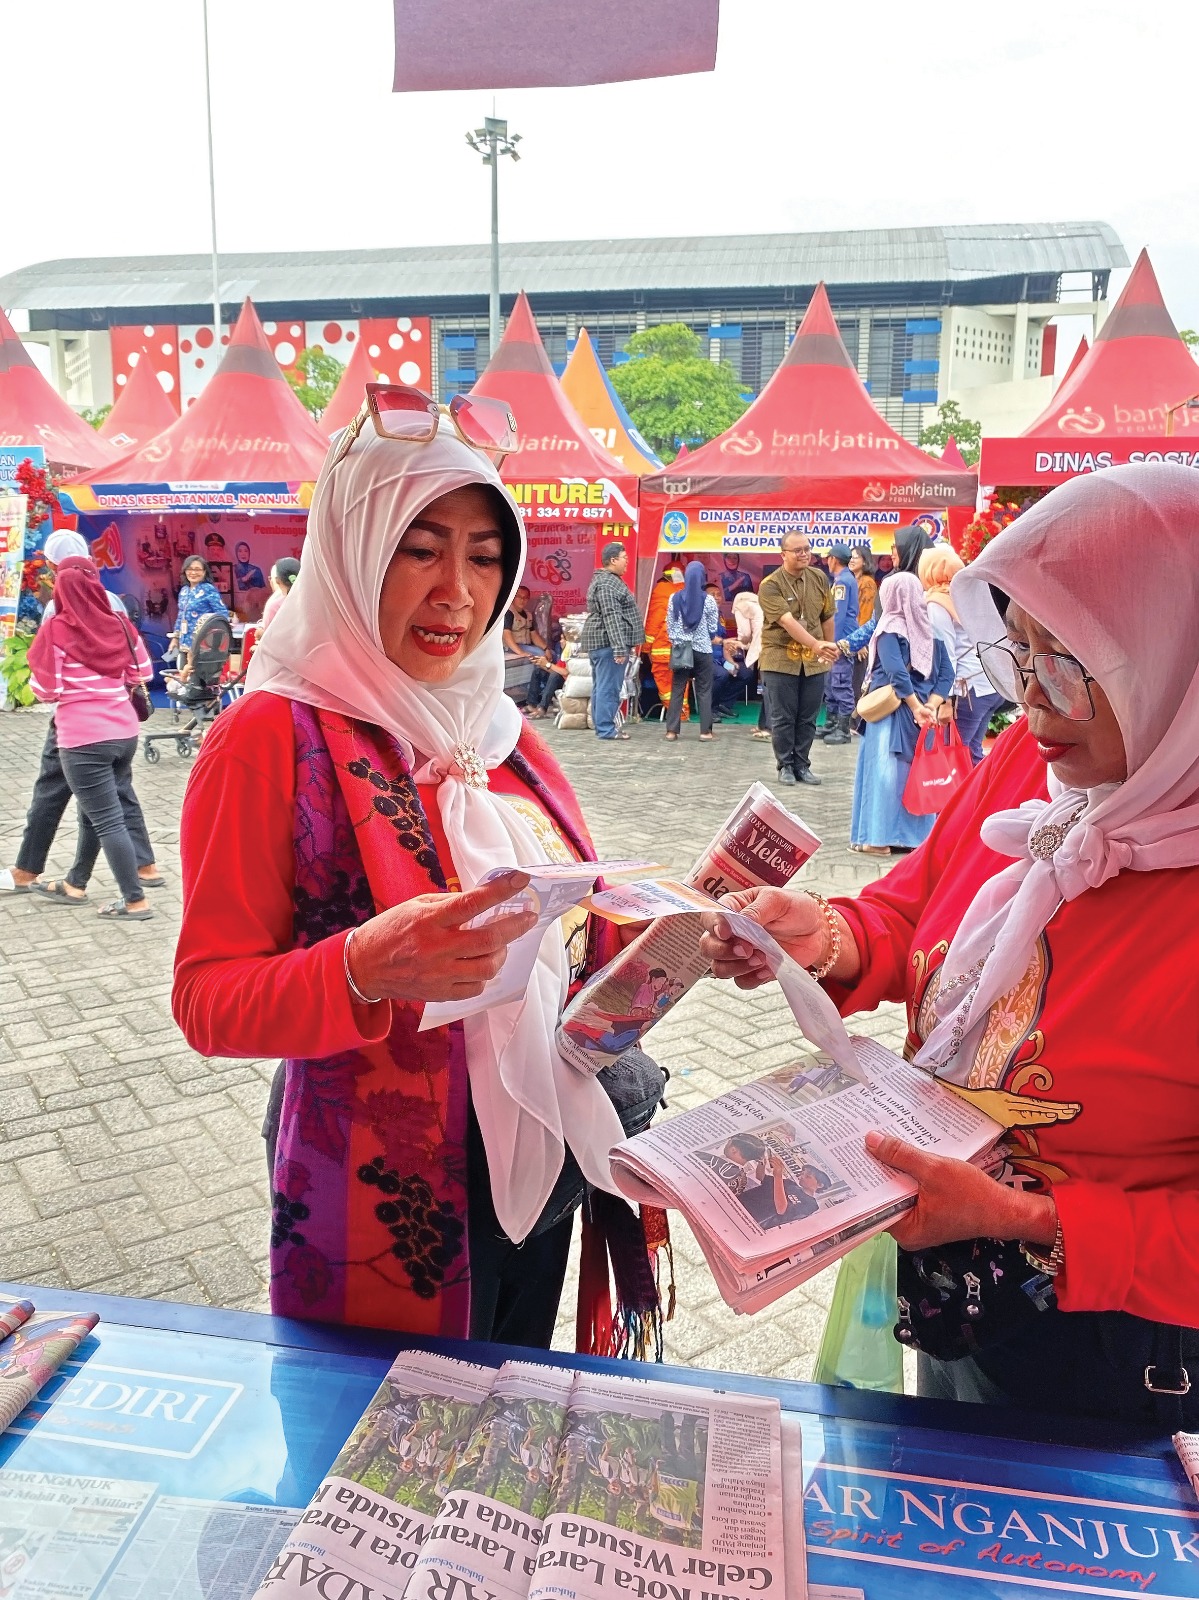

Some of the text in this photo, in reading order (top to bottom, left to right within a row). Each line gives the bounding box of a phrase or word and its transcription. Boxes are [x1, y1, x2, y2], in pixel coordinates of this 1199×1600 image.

[772, 429, 899, 452] bankjatim
[1035, 452, 1113, 472] DINAS
[889, 482, 956, 498] bankjatim
[99, 493, 299, 506] DINAS KESEHATAN KAB. NGANJUK
[536, 507, 560, 517] 334
[564, 507, 580, 517] 77
[582, 507, 613, 517] 8571
[700, 511, 899, 523] DINAS PEMADAM KEBAKARAN
[602, 522, 633, 536] FIT
[728, 524, 867, 535] DAN PENYELAMATAN
[897, 1118, 918, 1136] Hari
[915, 1135, 930, 1147] Ini
[907, 1115, 941, 1144] Sampel
[40, 1373, 213, 1424] EDIRI
[711, 1483, 765, 1496] Tradisi dengan
[721, 1477, 766, 1489] Biaya Mahal
[719, 1491, 766, 1504] Penghentian
[718, 1506, 747, 1516] Sambut
[733, 1500, 766, 1510] Gembira
[711, 1515, 729, 1524] Kota
[731, 1517, 739, 1526] di
[894, 1488, 1199, 1564] NGANJUK
[720, 1532, 766, 1543] hingga SMP
[740, 1527, 766, 1535] Negeri
[712, 1538, 766, 1551] Jenjang PAUD
[560, 1521, 774, 1591] Gelar Wisuda
[712, 1546, 766, 1558] Berlaku Mulai
[808, 1519, 1157, 1591] Spirit of Autonomy
[456, 1564, 485, 1583] Bukan
